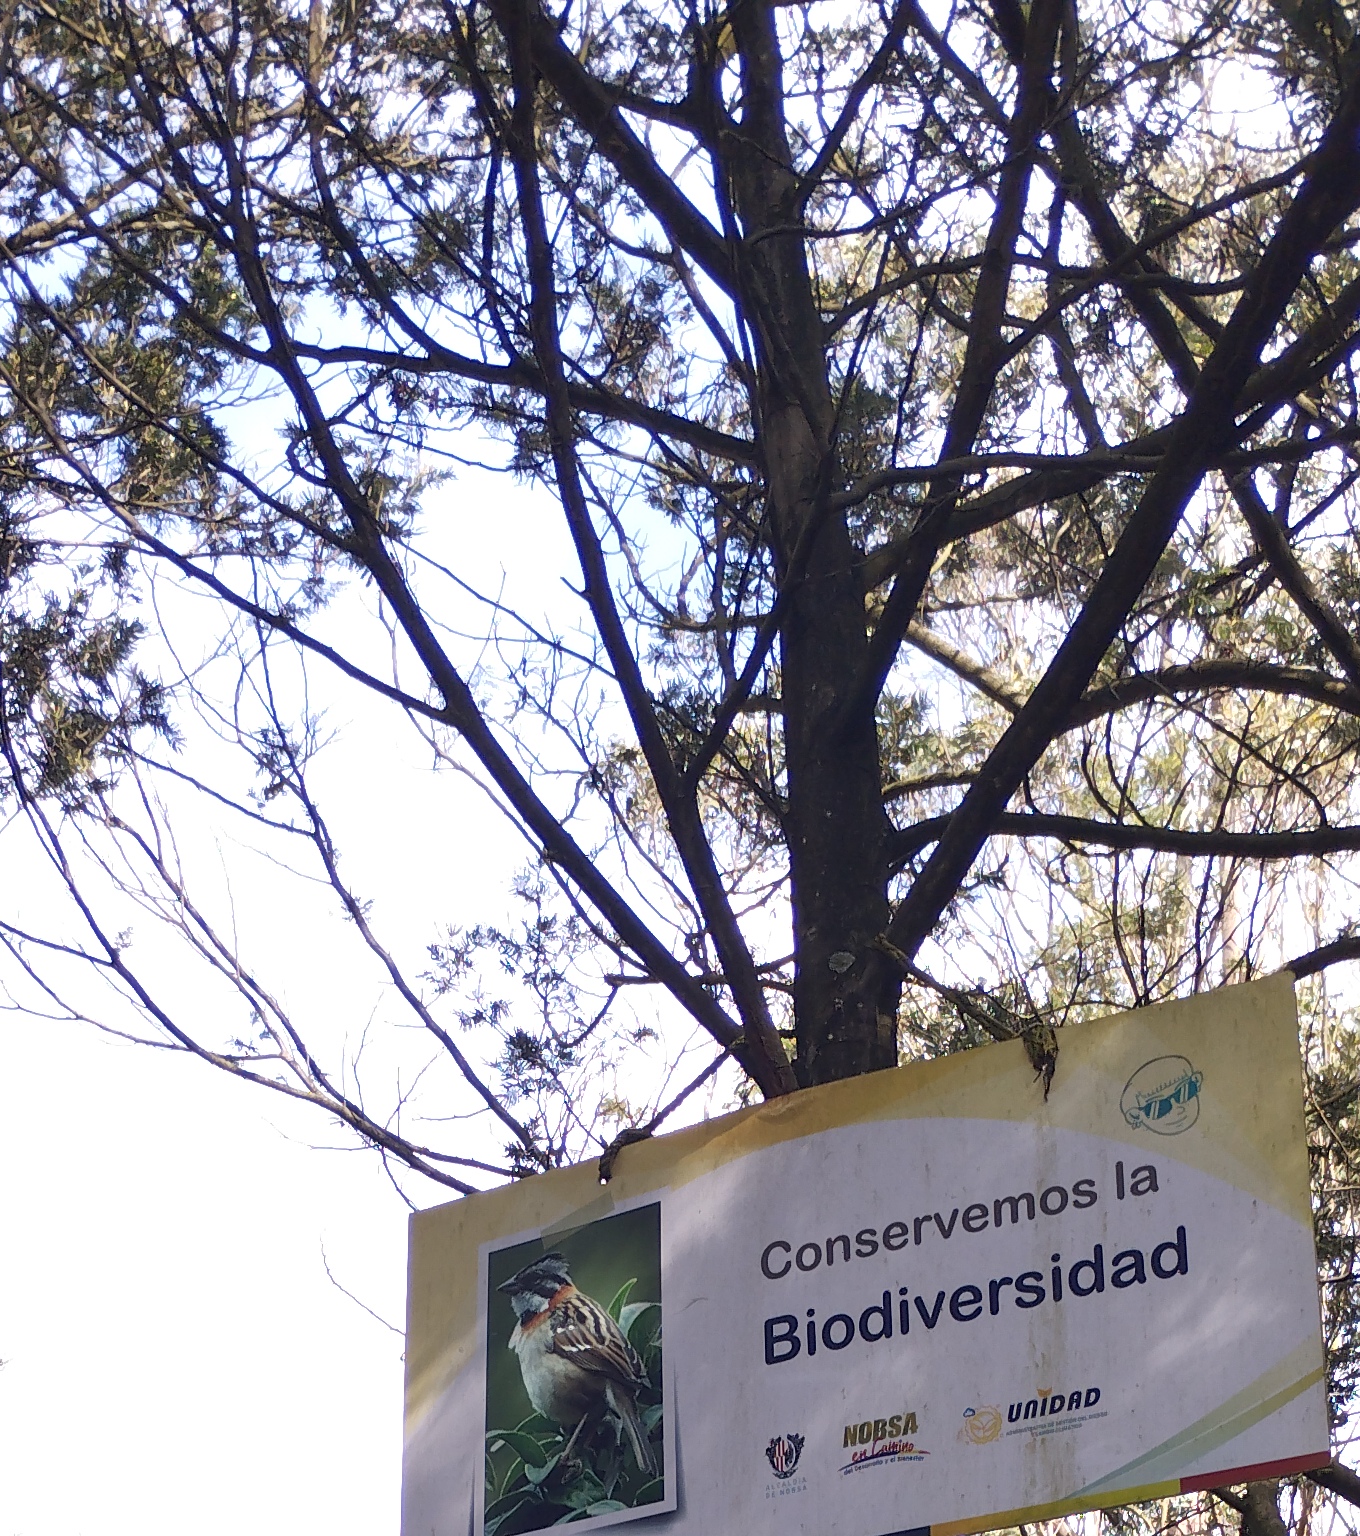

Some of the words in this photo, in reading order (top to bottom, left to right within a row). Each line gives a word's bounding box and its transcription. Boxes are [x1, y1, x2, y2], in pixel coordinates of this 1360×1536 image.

[760, 1178, 1098, 1280] Conservemos
[1115, 1160, 1159, 1200] la
[763, 1225, 1189, 1366] Biodiversidad
[1007, 1387, 1101, 1423] UNIDAD
[843, 1411, 919, 1449] NOBSA
[851, 1448, 868, 1463] en
[872, 1436, 915, 1458] Camino
[765, 1490, 776, 1500] DE
[779, 1484, 808, 1496] NOBSA
